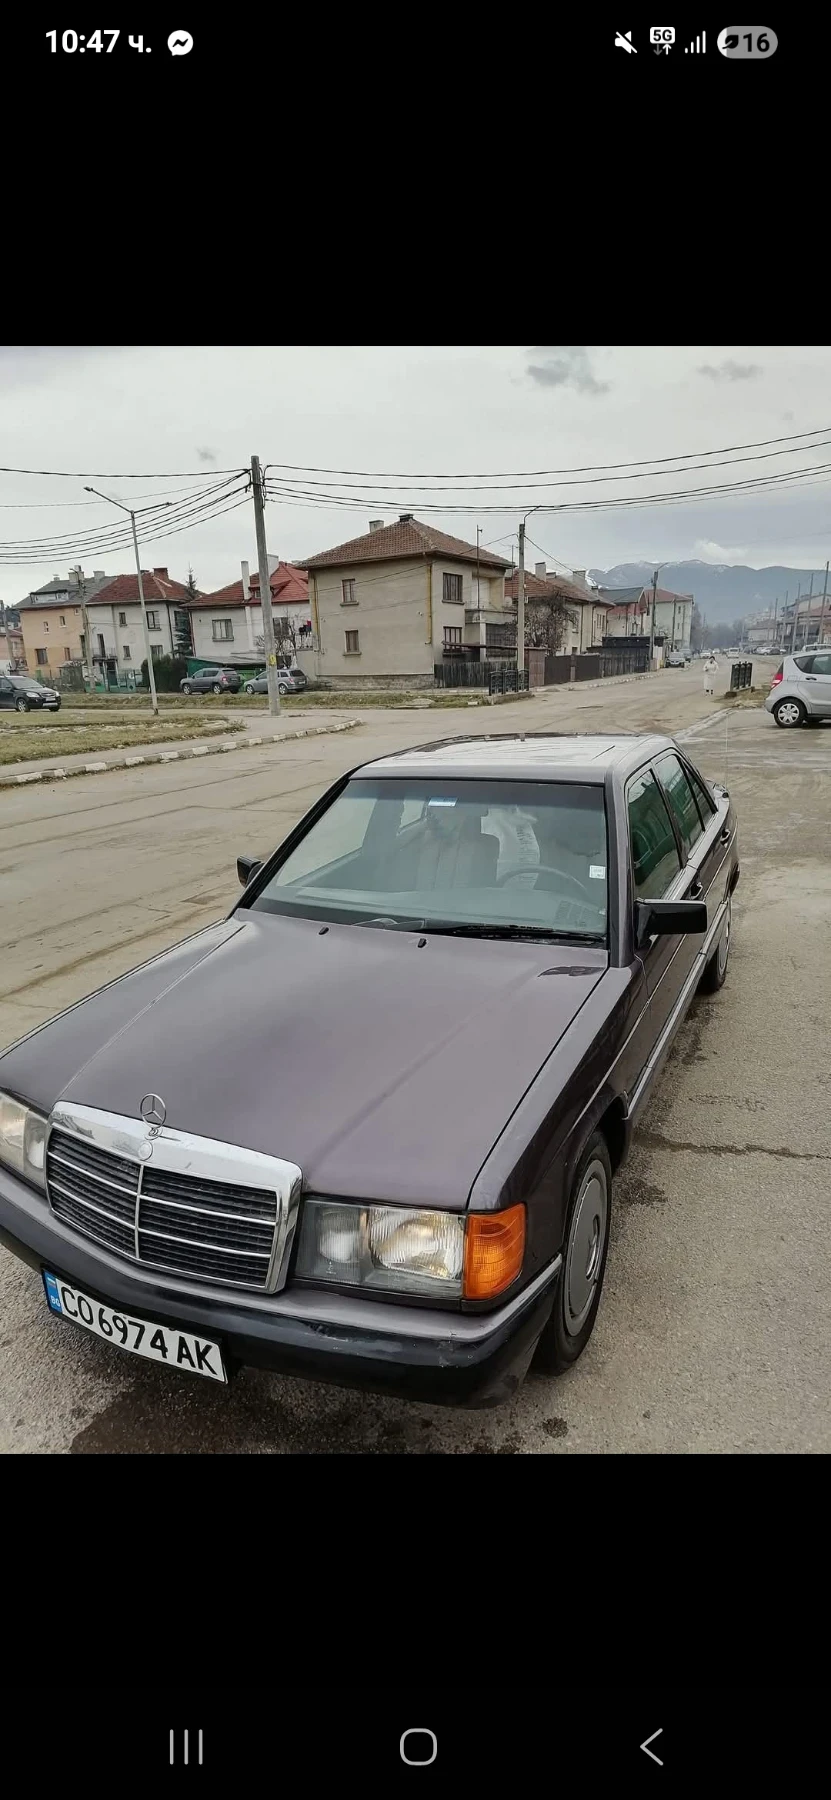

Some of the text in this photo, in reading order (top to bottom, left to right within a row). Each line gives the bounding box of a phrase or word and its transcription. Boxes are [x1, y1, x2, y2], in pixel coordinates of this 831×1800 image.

[60, 1286, 218, 1376] CO 6974 AK
